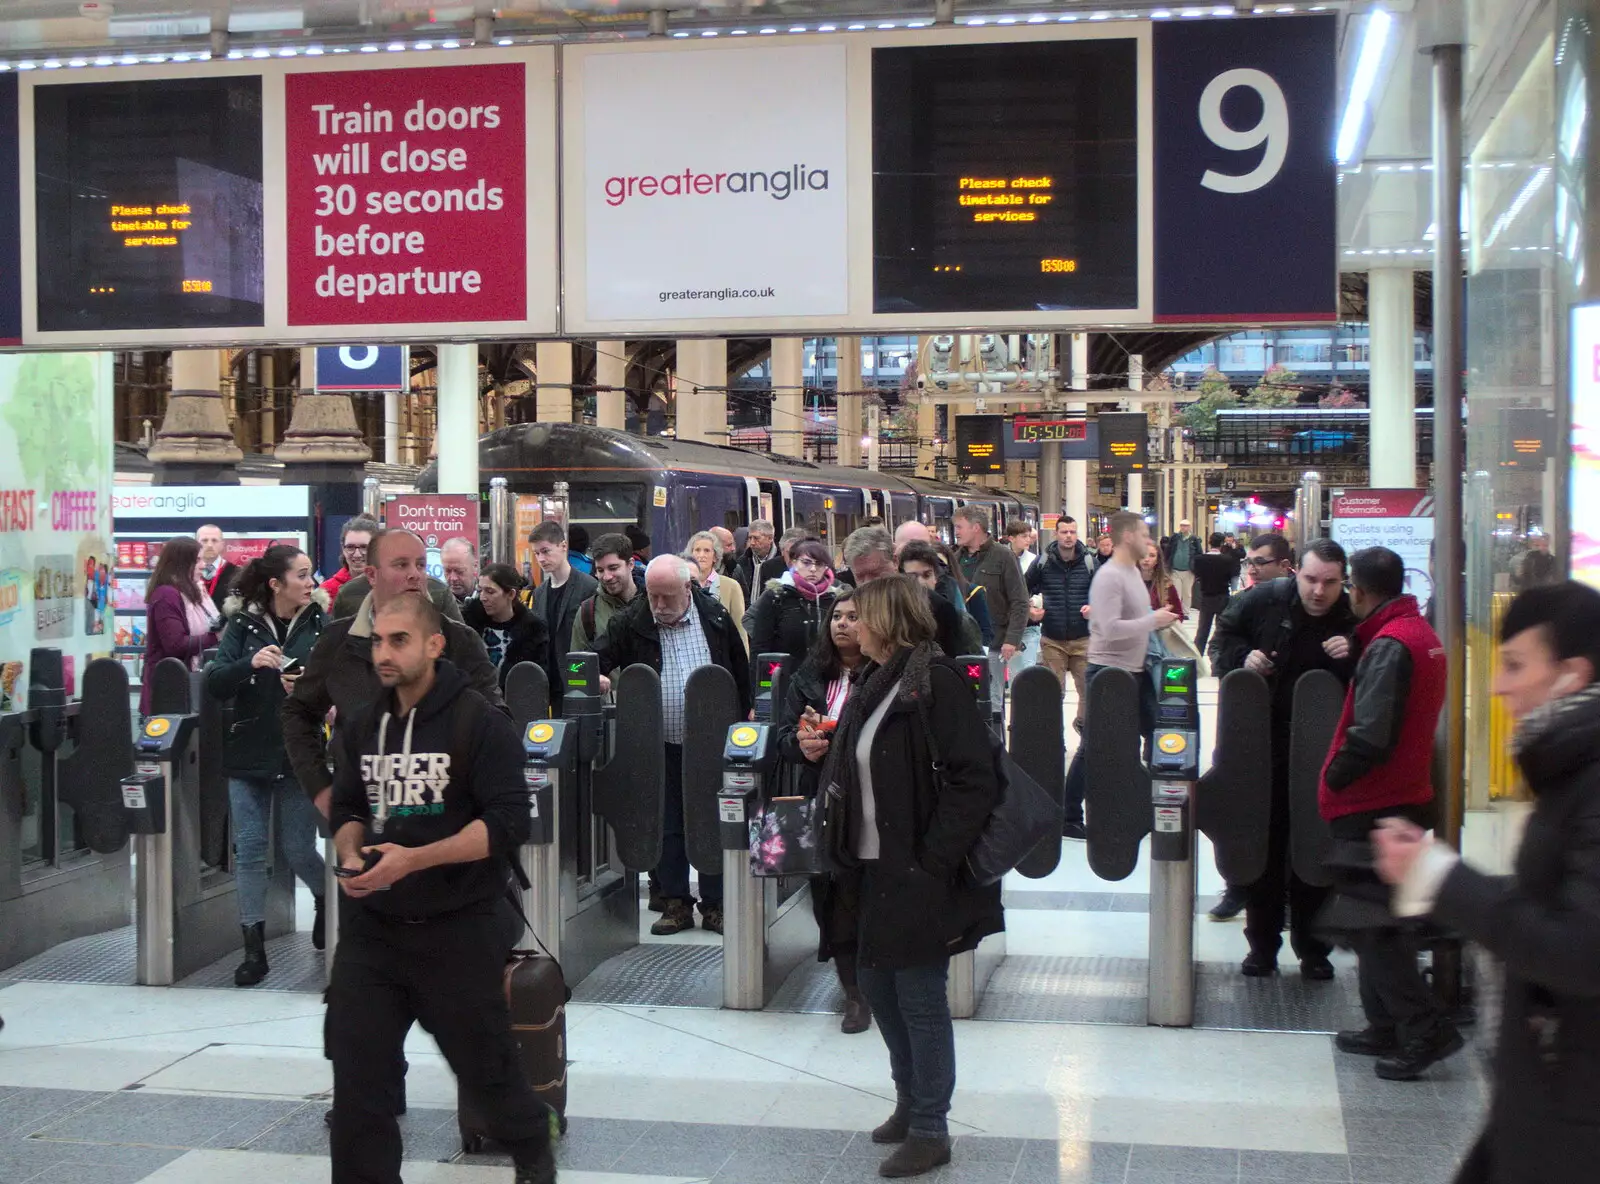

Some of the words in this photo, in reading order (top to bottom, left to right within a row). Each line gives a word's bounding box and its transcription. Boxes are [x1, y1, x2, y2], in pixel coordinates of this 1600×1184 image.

[311, 101, 393, 135] Train
[404, 99, 500, 132] doors
[1199, 67, 1290, 194] 9
[312, 141, 370, 176] will
[380, 140, 468, 174] close
[604, 163, 830, 207] greateranglia
[959, 177, 1006, 189] Please
[1011, 176, 1051, 188] check
[314, 183, 357, 217] 30
[366, 178, 504, 215] seconds
[959, 193, 1023, 206] timetable
[1028, 193, 1051, 205] for
[111, 205, 152, 217] Please
[156, 203, 191, 214] check
[973, 210, 1035, 222] services
[111, 219, 167, 231] timetable
[171, 219, 192, 230] for
[124, 235, 177, 247] services
[315, 224, 425, 257] before
[315, 265, 481, 304] departure
[658, 286, 776, 303] greateranglia.co.uk
[1339, 497, 1381, 506] Customer
[0, 489, 36, 532] FAST
[51, 490, 97, 532] COFFEE
[398, 504, 434, 518] Don't
[437, 504, 467, 518] miss
[401, 520, 431, 532] your
[434, 519, 463, 532] train
[1338, 523, 1380, 535] Cyclists
[1383, 524, 1414, 536] using
